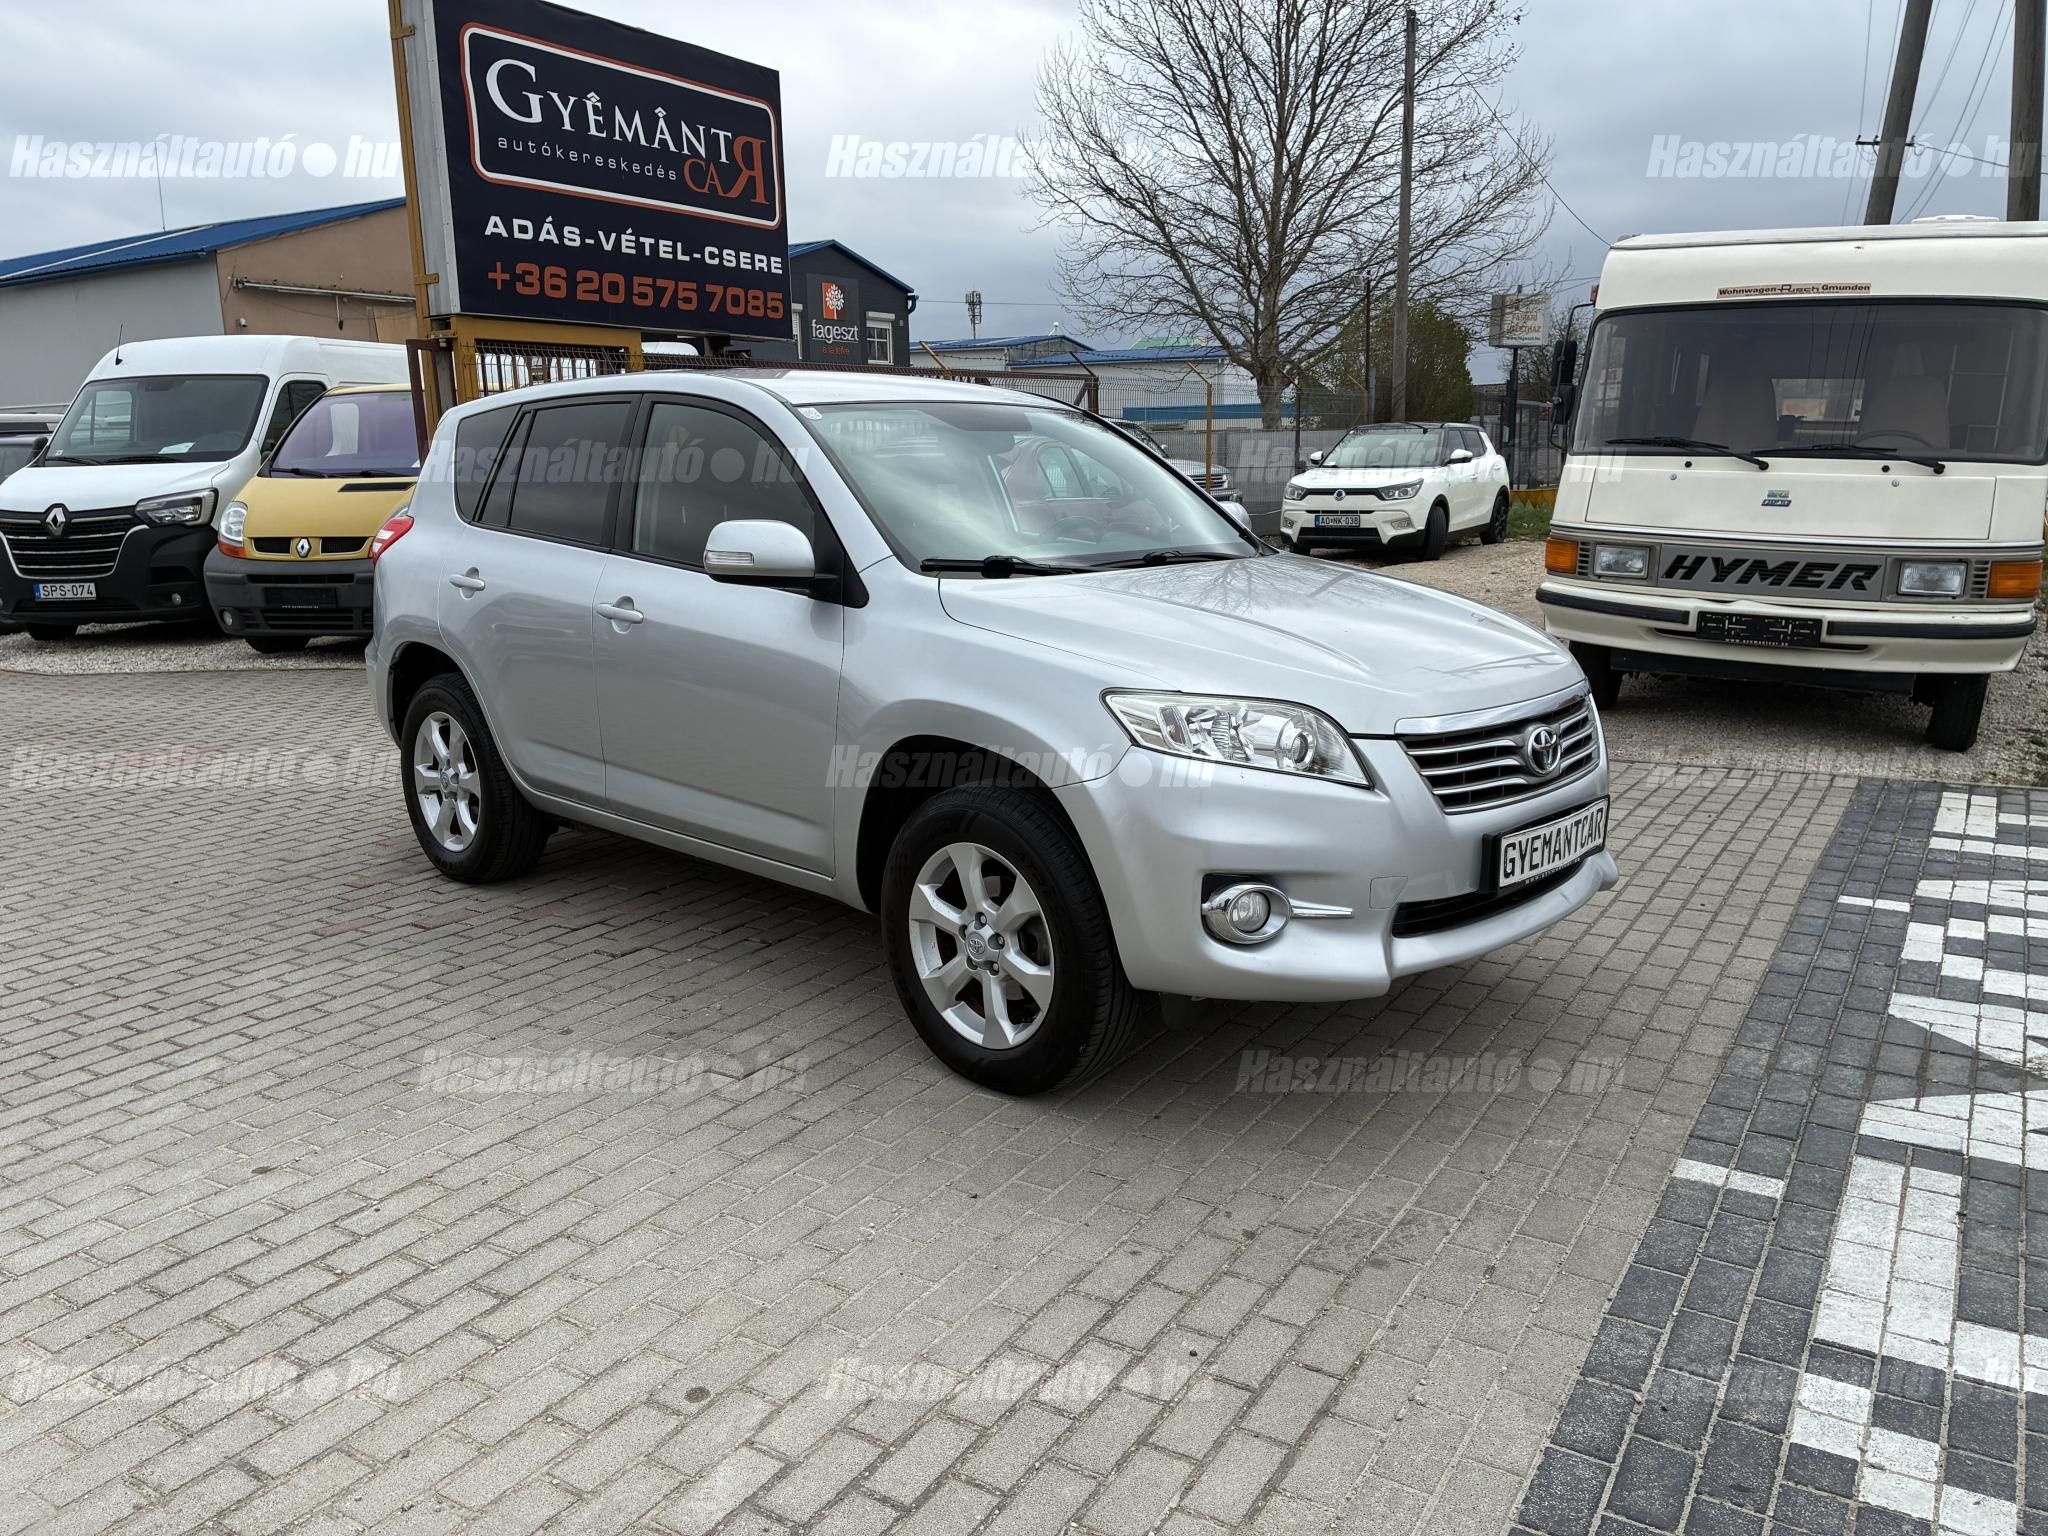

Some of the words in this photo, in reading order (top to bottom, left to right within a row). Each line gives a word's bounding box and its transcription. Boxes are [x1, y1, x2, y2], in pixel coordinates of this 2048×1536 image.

[497, 136, 677, 181] autókereskedés
[484, 215, 784, 275] ADÁS-VÉTEL-CSERE
[487, 261, 568, 299] +36
[576, 270, 625, 304] 20
[632, 275, 699, 311] 575
[705, 284, 785, 319] 7085
[1821, 284, 1871, 293] Gmunden
[811, 319, 859, 344] fageszt
[42, 584, 94, 597] SPS-074
[1661, 554, 1882, 592] HYMER
[1503, 806, 1604, 880] GYEMANTCAR
